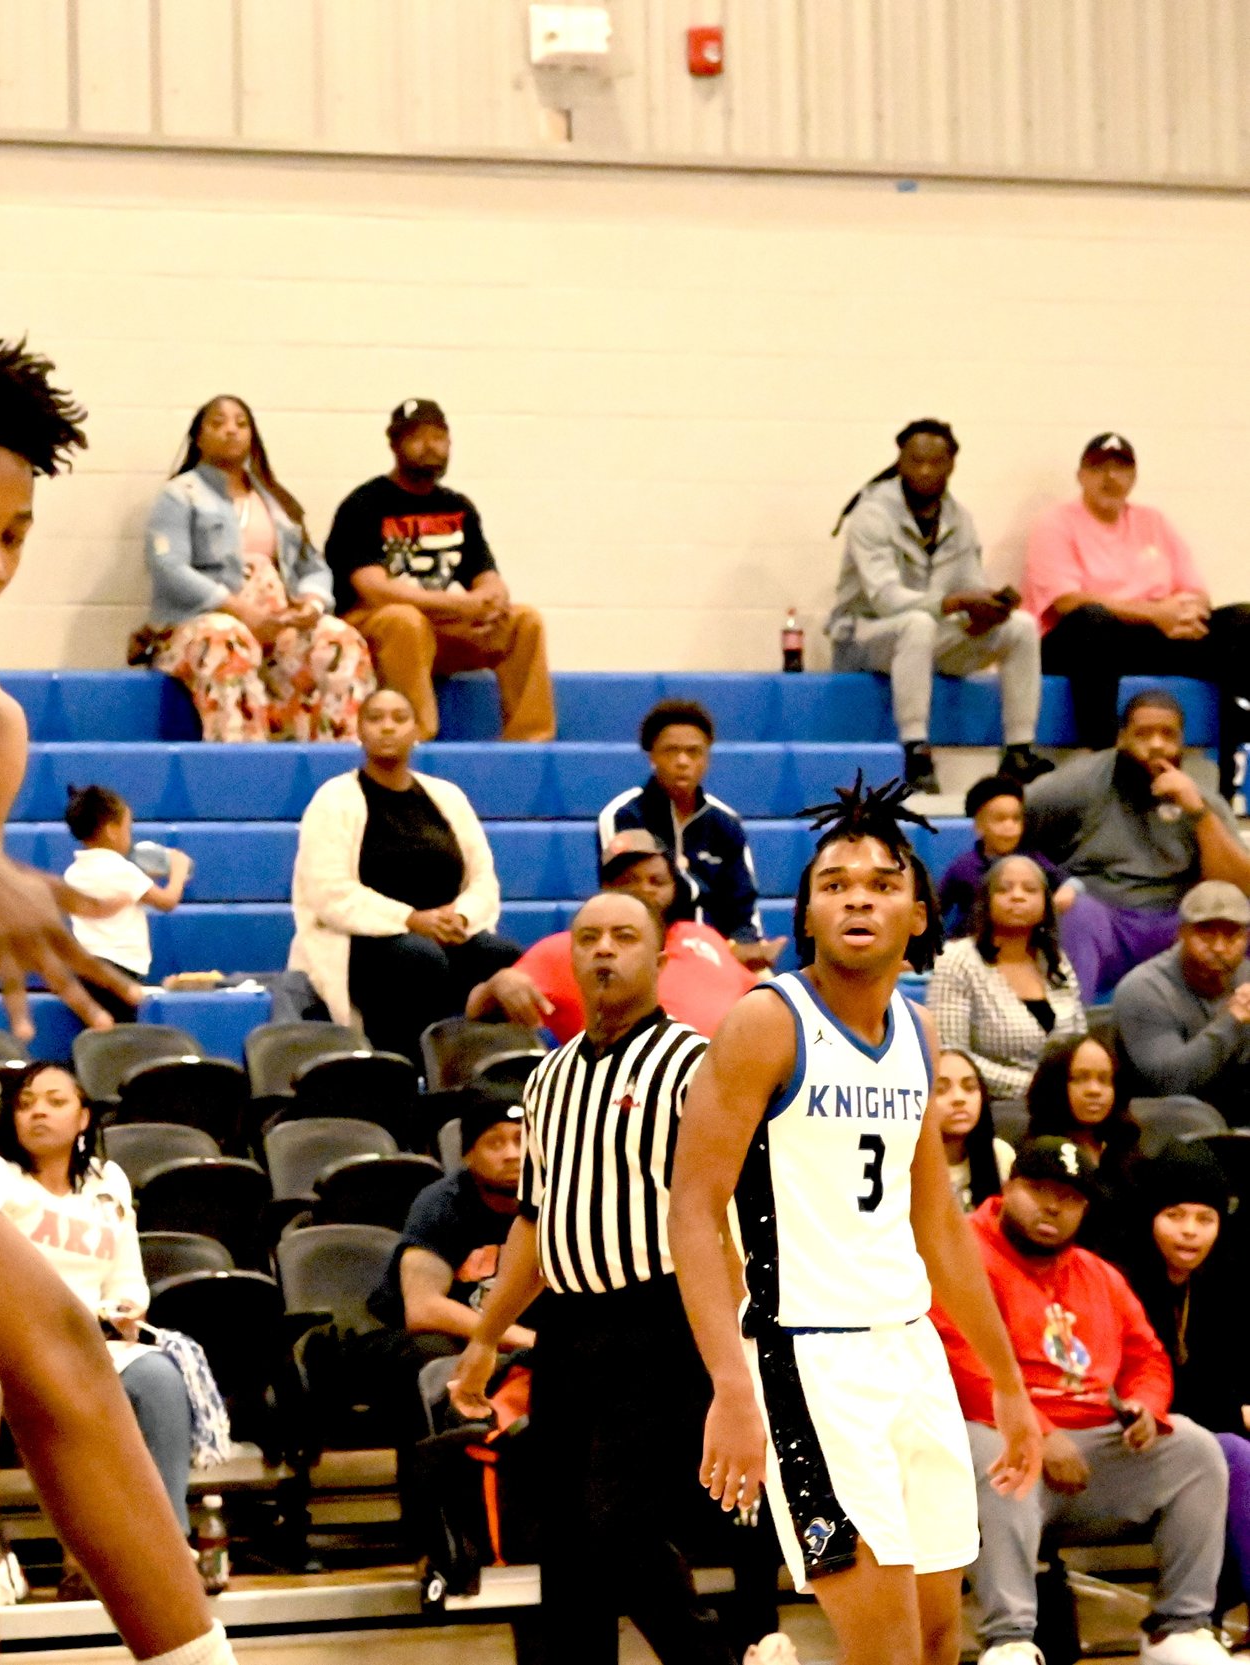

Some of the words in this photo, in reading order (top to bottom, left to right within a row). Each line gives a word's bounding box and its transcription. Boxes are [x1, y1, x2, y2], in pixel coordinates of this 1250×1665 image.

[806, 1085, 923, 1121] KNIGHTS
[857, 1133, 886, 1213] 3
[30, 1209, 117, 1261] AKA
